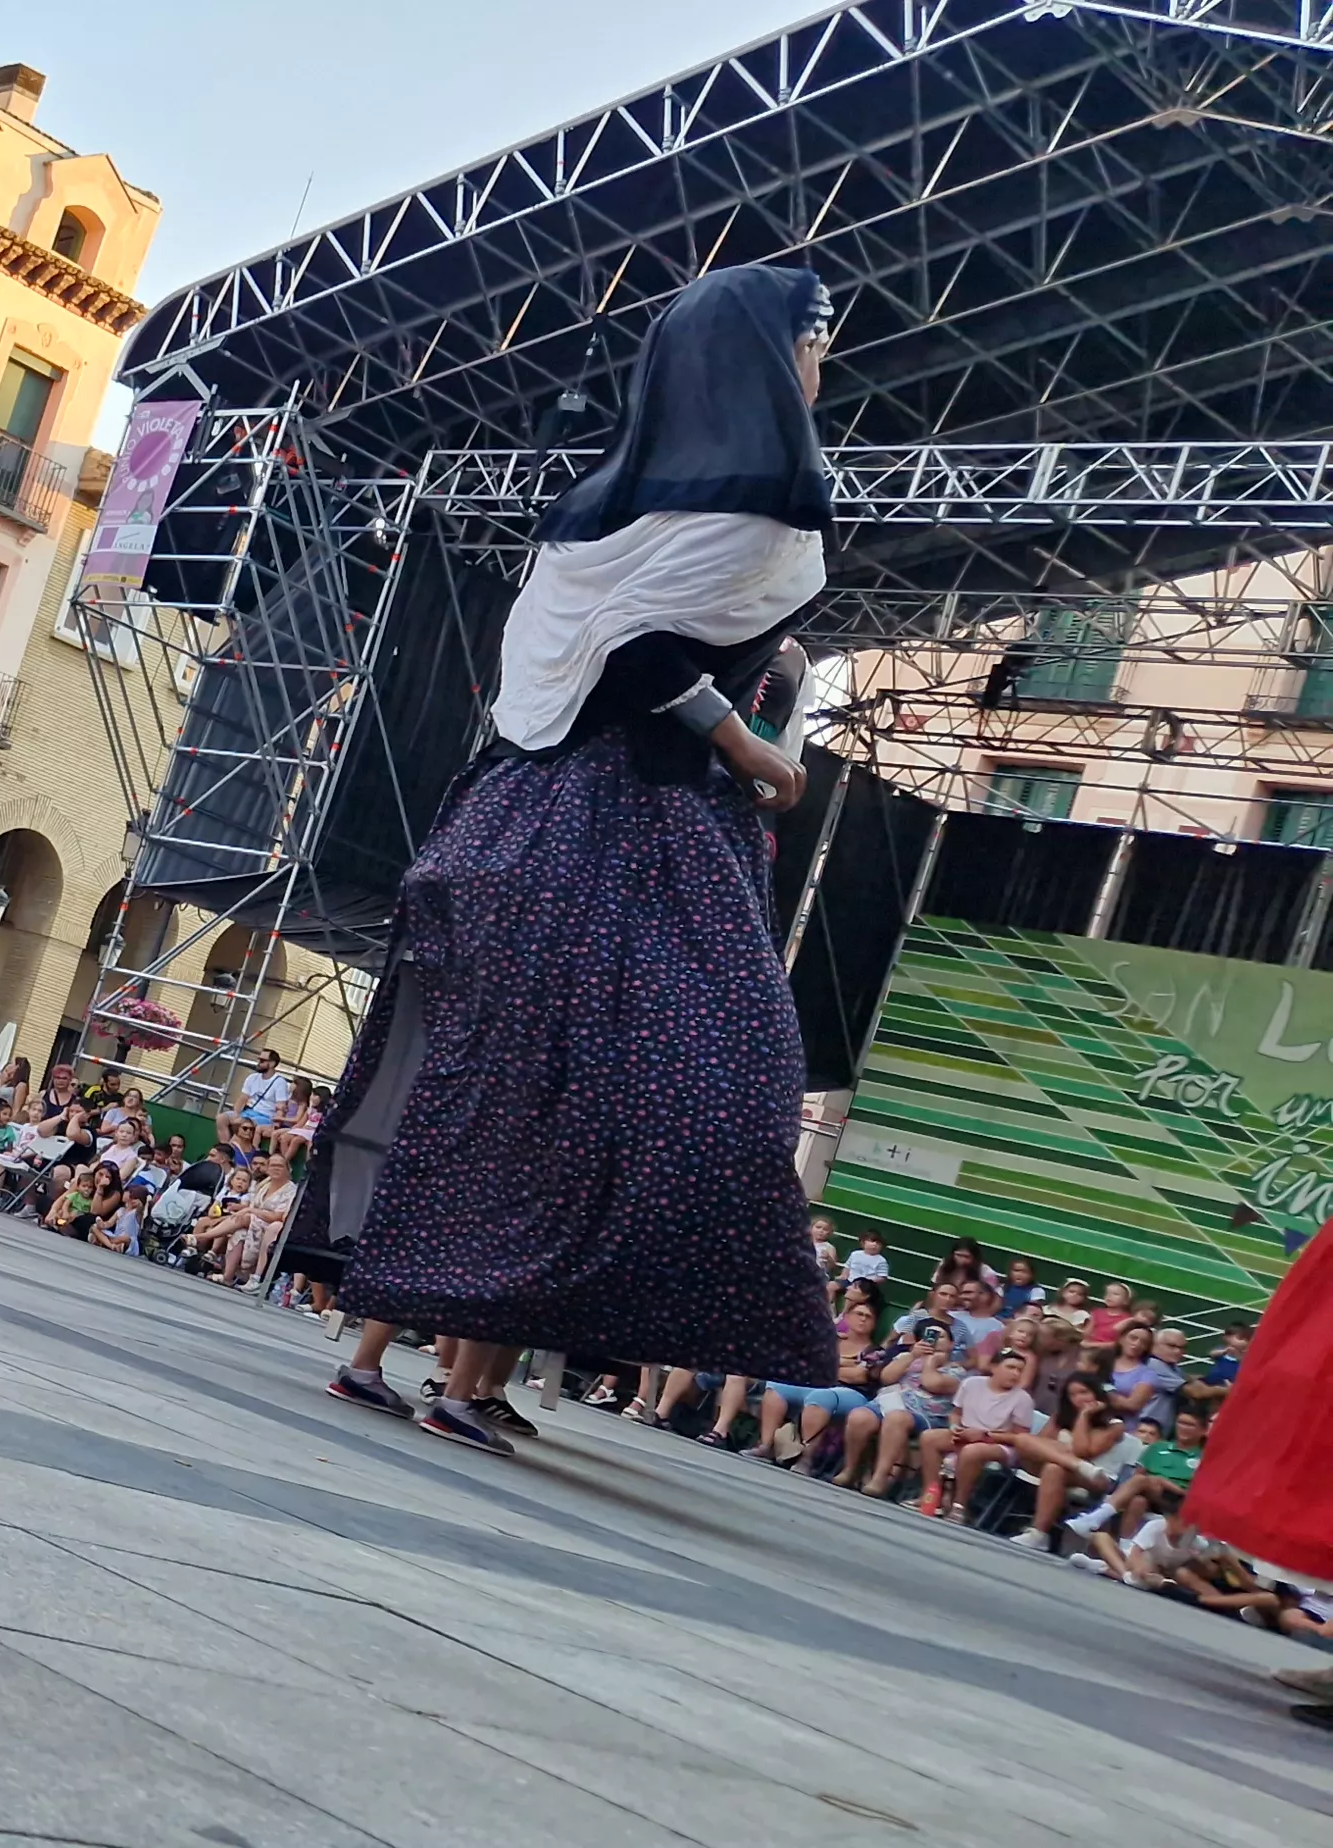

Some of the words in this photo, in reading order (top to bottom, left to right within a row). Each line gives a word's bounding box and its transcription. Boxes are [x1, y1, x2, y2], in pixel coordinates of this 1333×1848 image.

[137, 418, 184, 440] VIOLETA
[1101, 961, 1231, 1038] SAN
[1256, 978, 1333, 1064] L
[1134, 1054, 1243, 1118] Por
